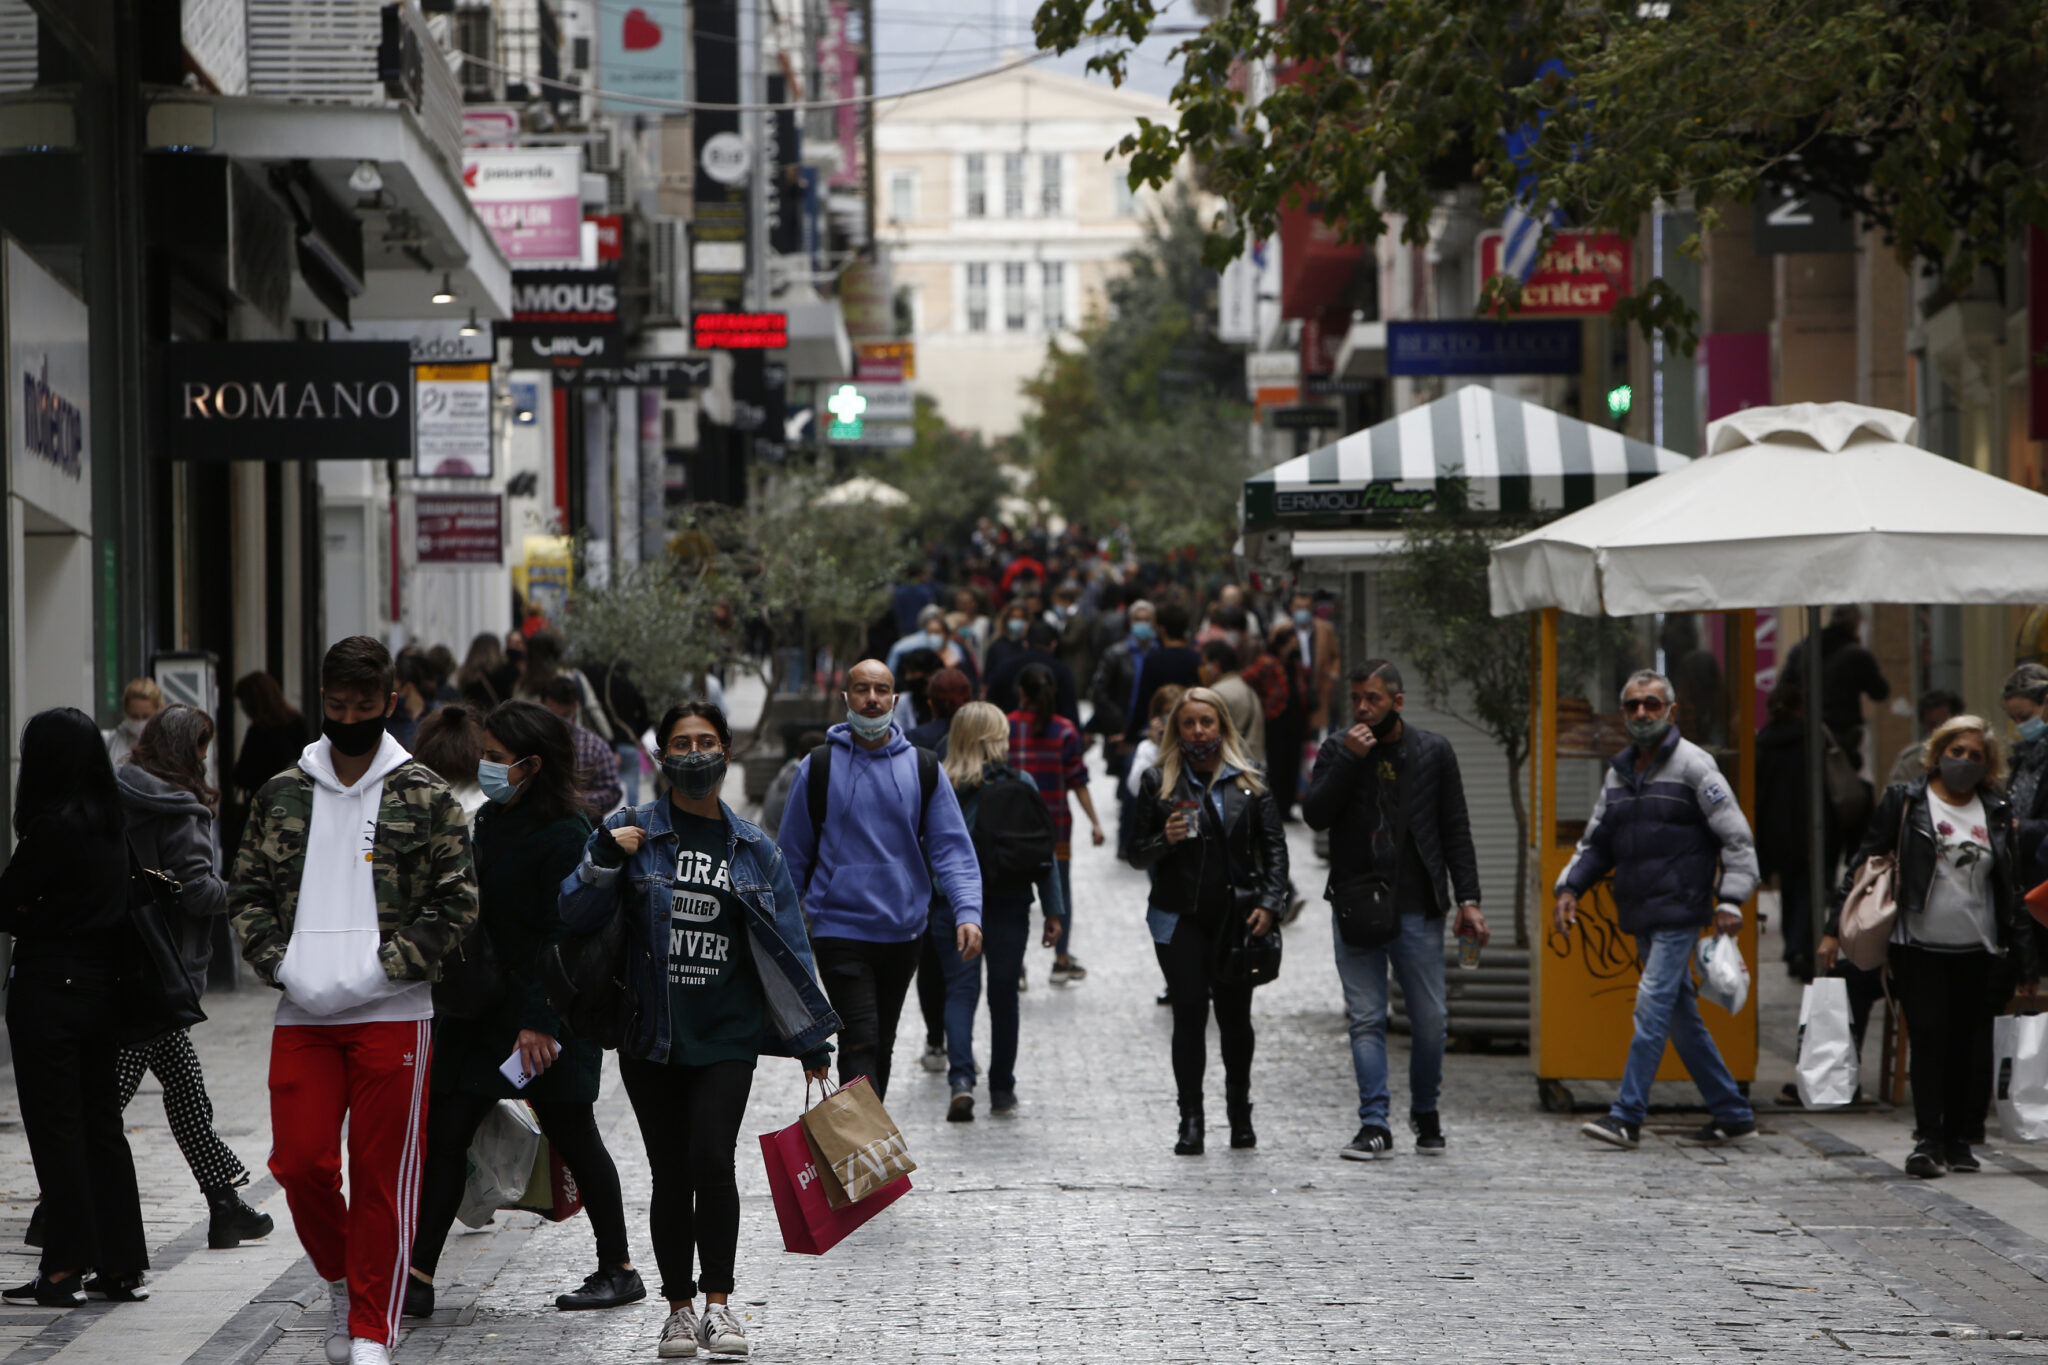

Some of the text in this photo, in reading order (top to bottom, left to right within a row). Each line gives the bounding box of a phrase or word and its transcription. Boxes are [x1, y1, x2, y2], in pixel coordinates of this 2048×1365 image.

[182, 381, 400, 420] ROMANO
[1277, 492, 1360, 511] ERMOU
[680, 964, 720, 976] UNIVERSITY
[681, 976, 706, 985] STATES
